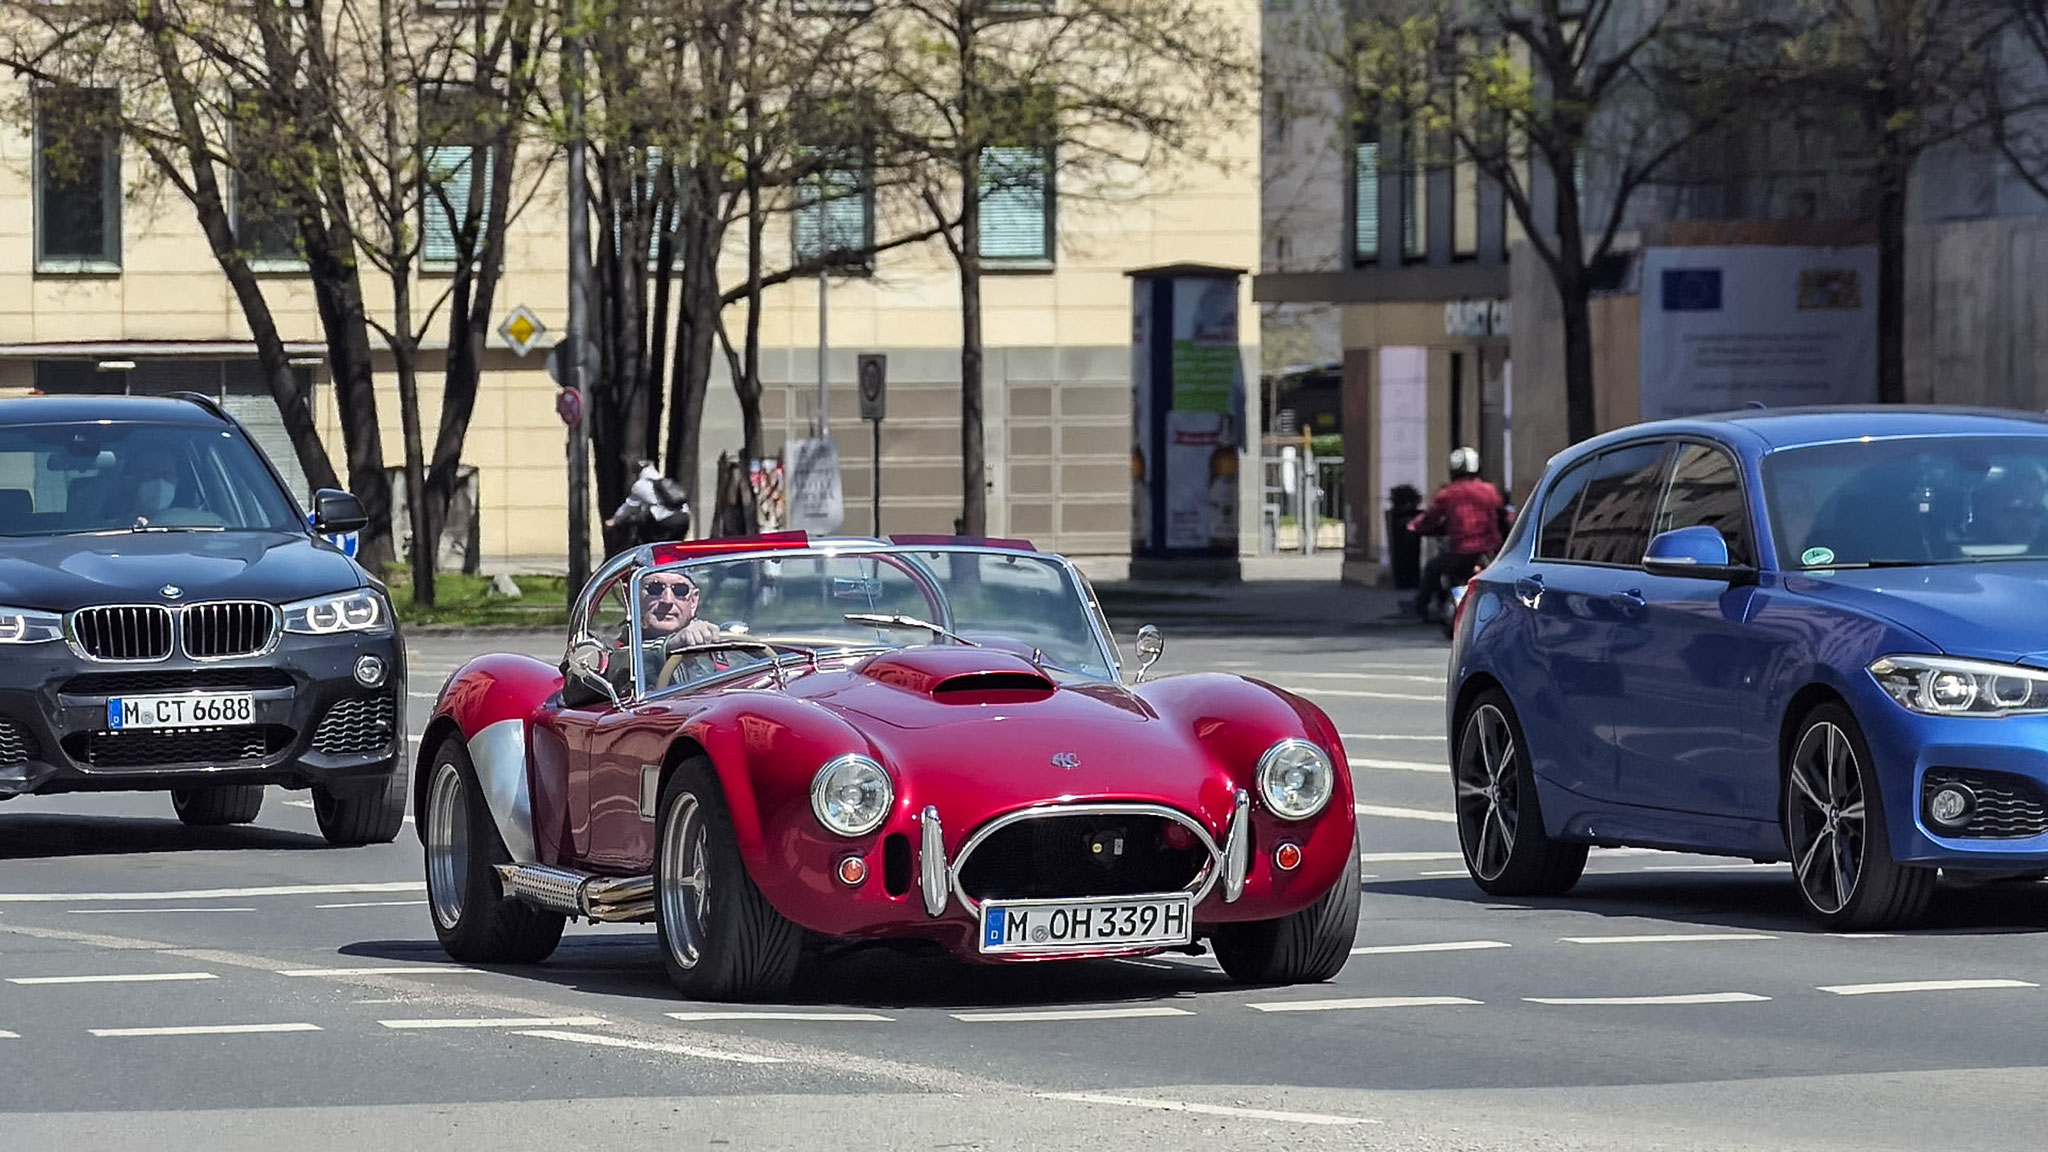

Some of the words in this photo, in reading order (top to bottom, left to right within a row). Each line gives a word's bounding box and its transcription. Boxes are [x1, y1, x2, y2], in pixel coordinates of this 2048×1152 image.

[124, 701, 139, 724] M
[156, 700, 186, 723] CT
[193, 698, 251, 721] 6688
[990, 930, 999, 940] D
[1006, 911, 1029, 942] M
